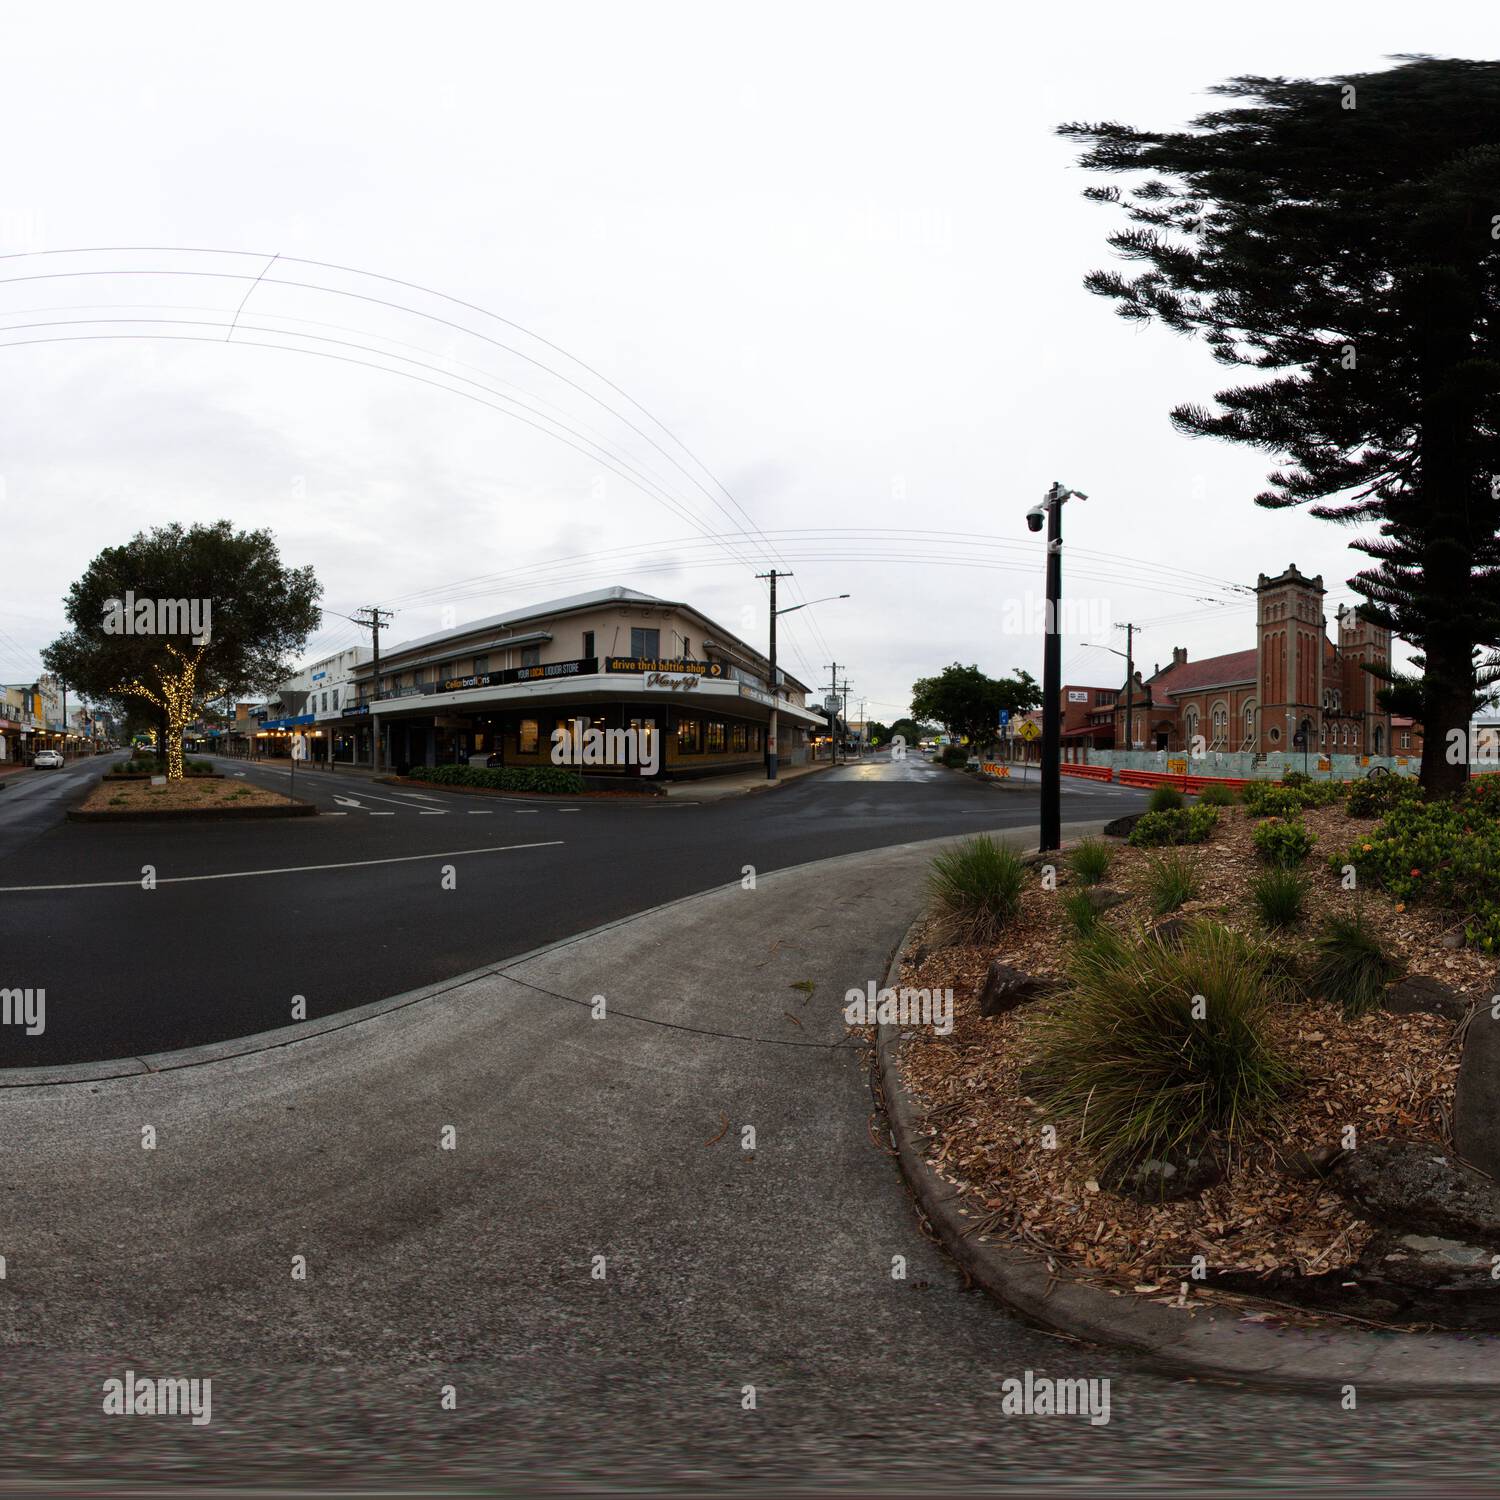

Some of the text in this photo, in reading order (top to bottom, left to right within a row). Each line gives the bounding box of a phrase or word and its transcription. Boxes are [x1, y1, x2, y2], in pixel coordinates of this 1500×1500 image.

[517, 662, 580, 680] YOUR LOCAL LIQUOR STORE
[612, 659, 706, 674] drive thru bottle shop
